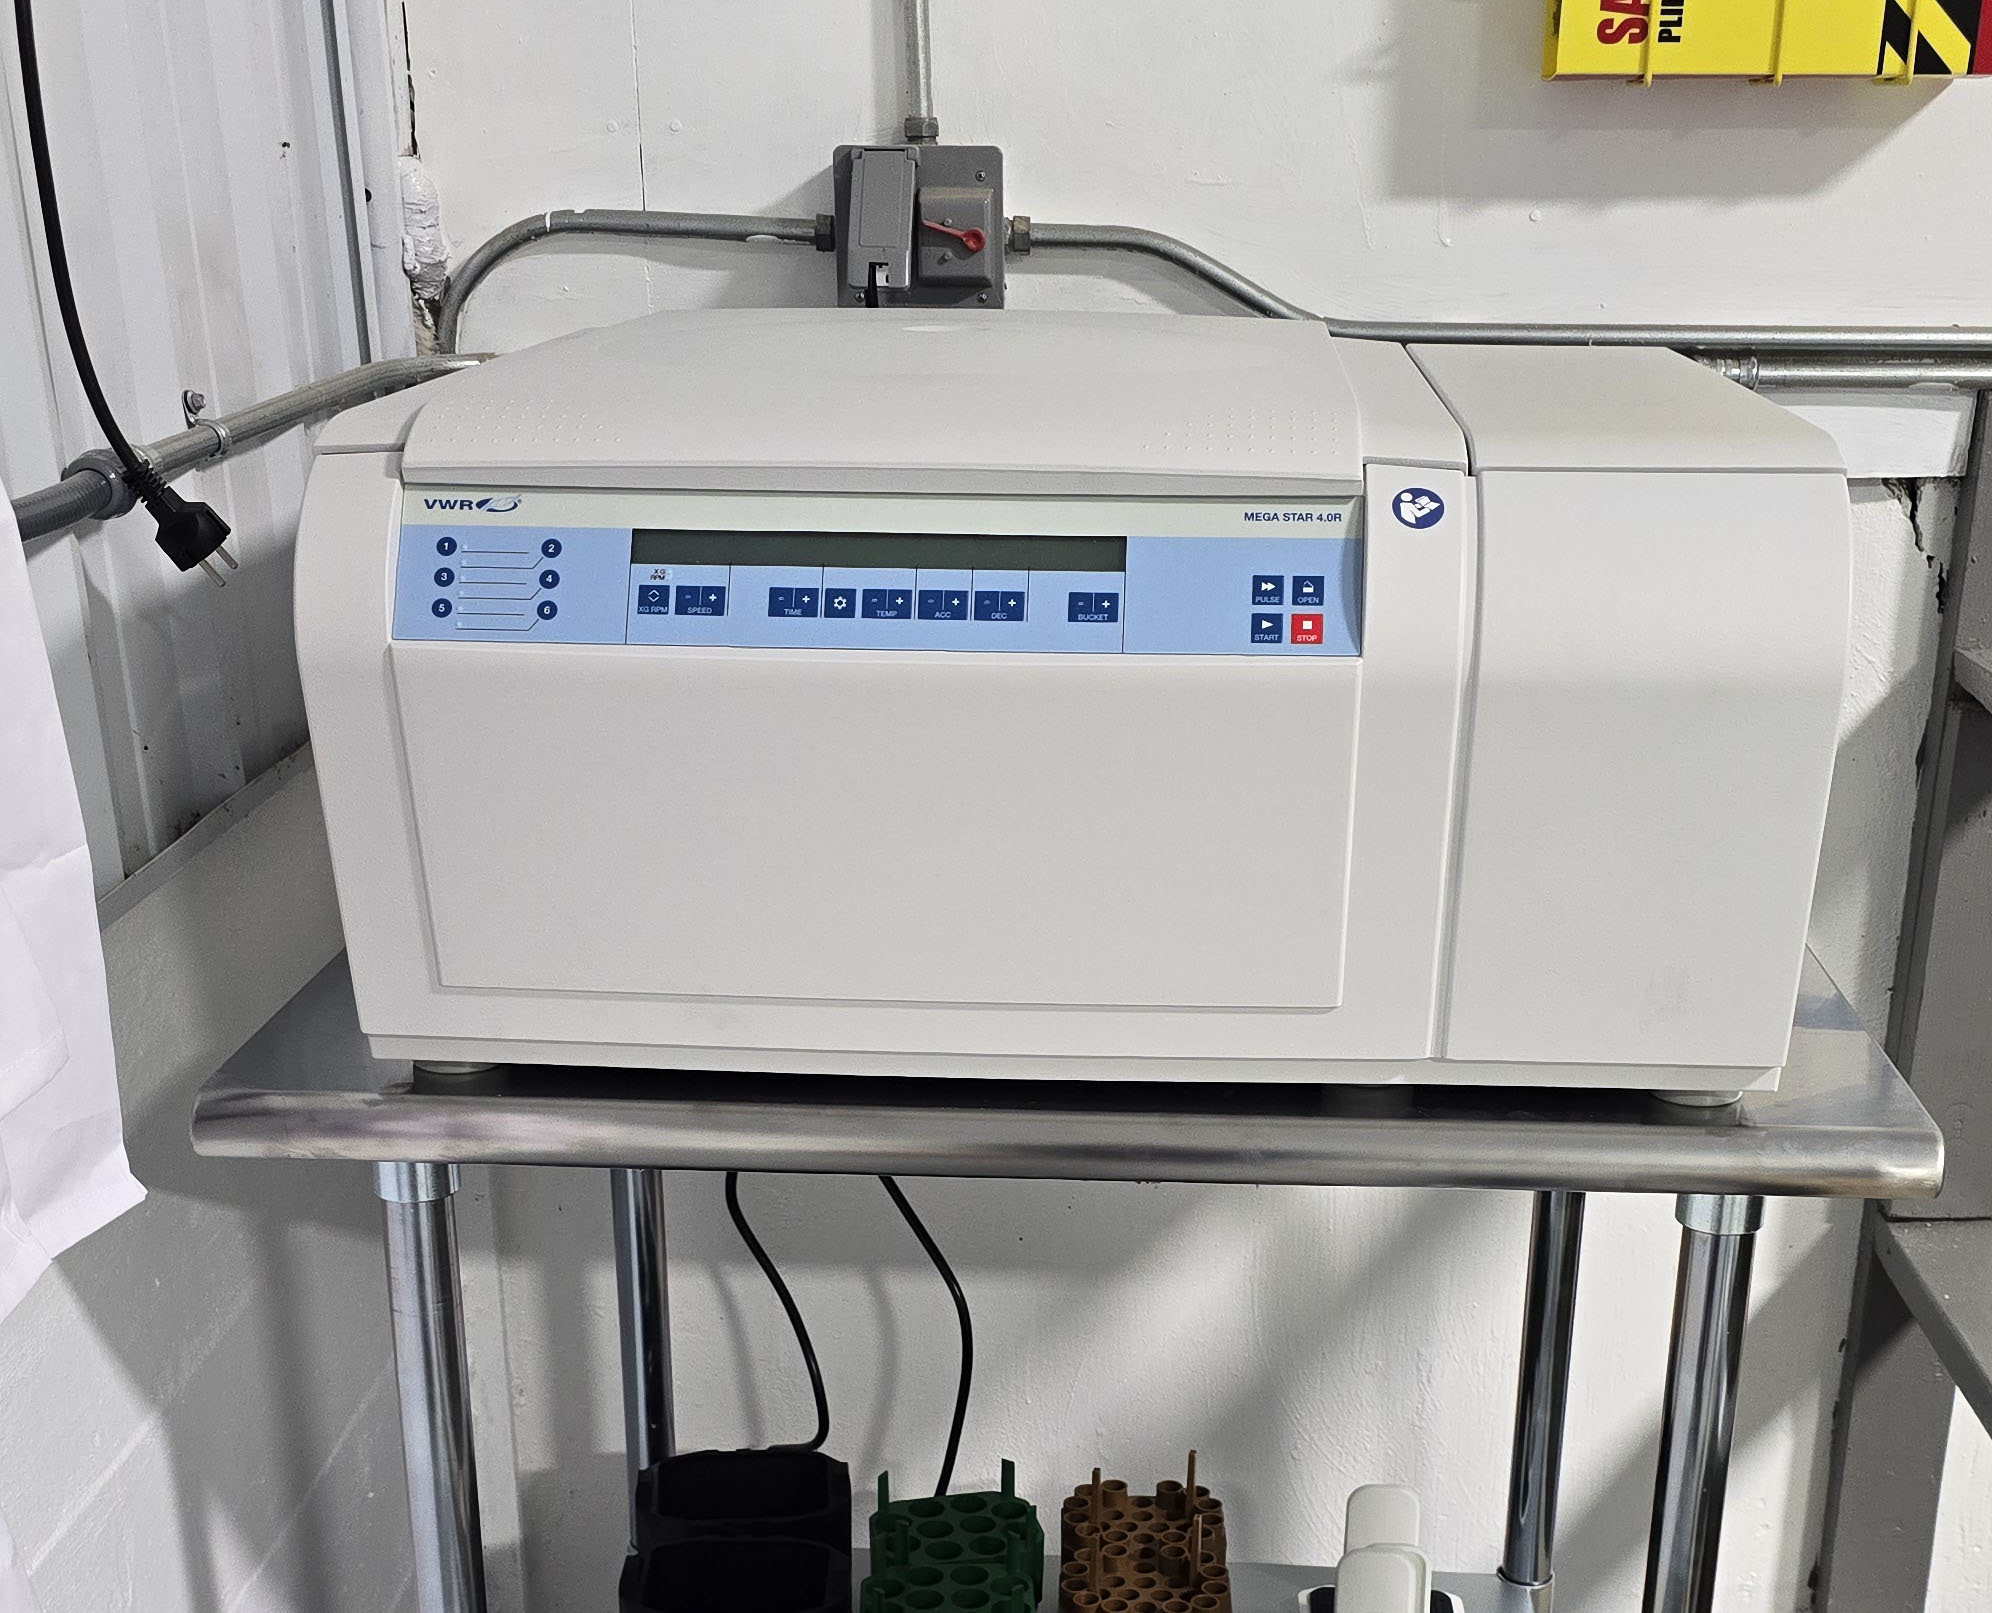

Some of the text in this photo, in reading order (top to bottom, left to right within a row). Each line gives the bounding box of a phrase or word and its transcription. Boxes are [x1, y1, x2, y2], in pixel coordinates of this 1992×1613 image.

[423, 498, 474, 511] VWR
[1243, 511, 1342, 523] MEGA STAR 4.0R
[1255, 596, 1281, 604] PULSE
[1297, 596, 1320, 604] OPEN
[650, 605, 668, 614] RPM
[687, 606, 713, 614] SPEED
[783, 608, 803, 616] TIME
[875, 609, 899, 618] TEMP
[933, 611, 952, 619] ACC
[990, 612, 1008, 620] DEC
[1077, 613, 1109, 621] BUCKET
[1254, 633, 1280, 642] START
[1296, 633, 1318, 642] STOP
